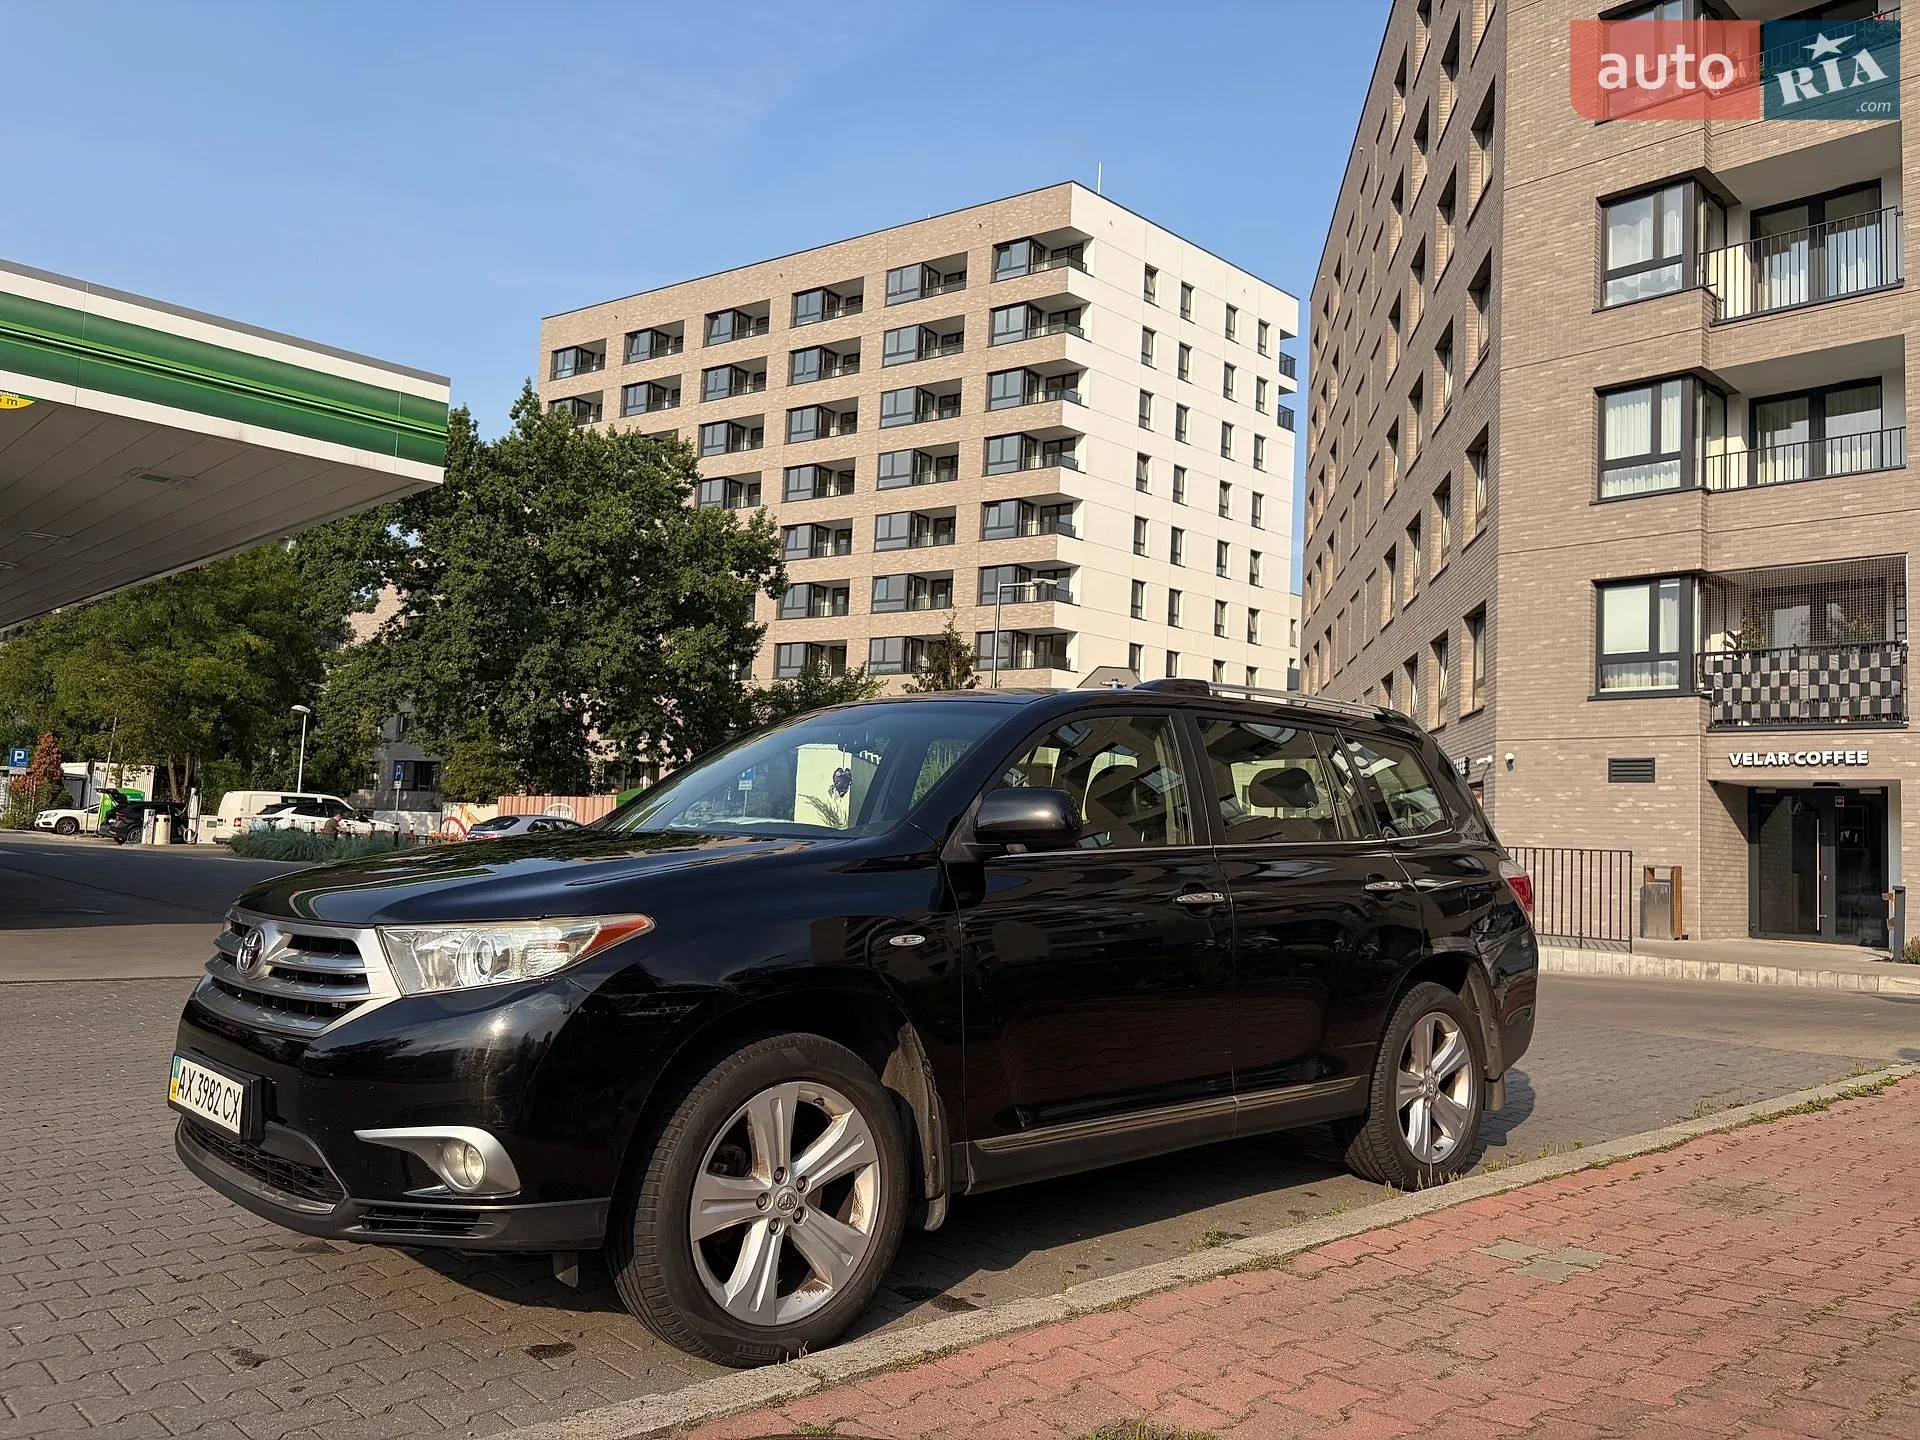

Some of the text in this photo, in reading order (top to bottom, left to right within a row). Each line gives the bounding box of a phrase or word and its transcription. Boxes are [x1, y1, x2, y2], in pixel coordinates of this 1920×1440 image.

[14, 750, 25, 762] P
[1728, 750, 1869, 767] VELAR COFFEE
[176, 1065, 241, 1126] AX 3982 CX
